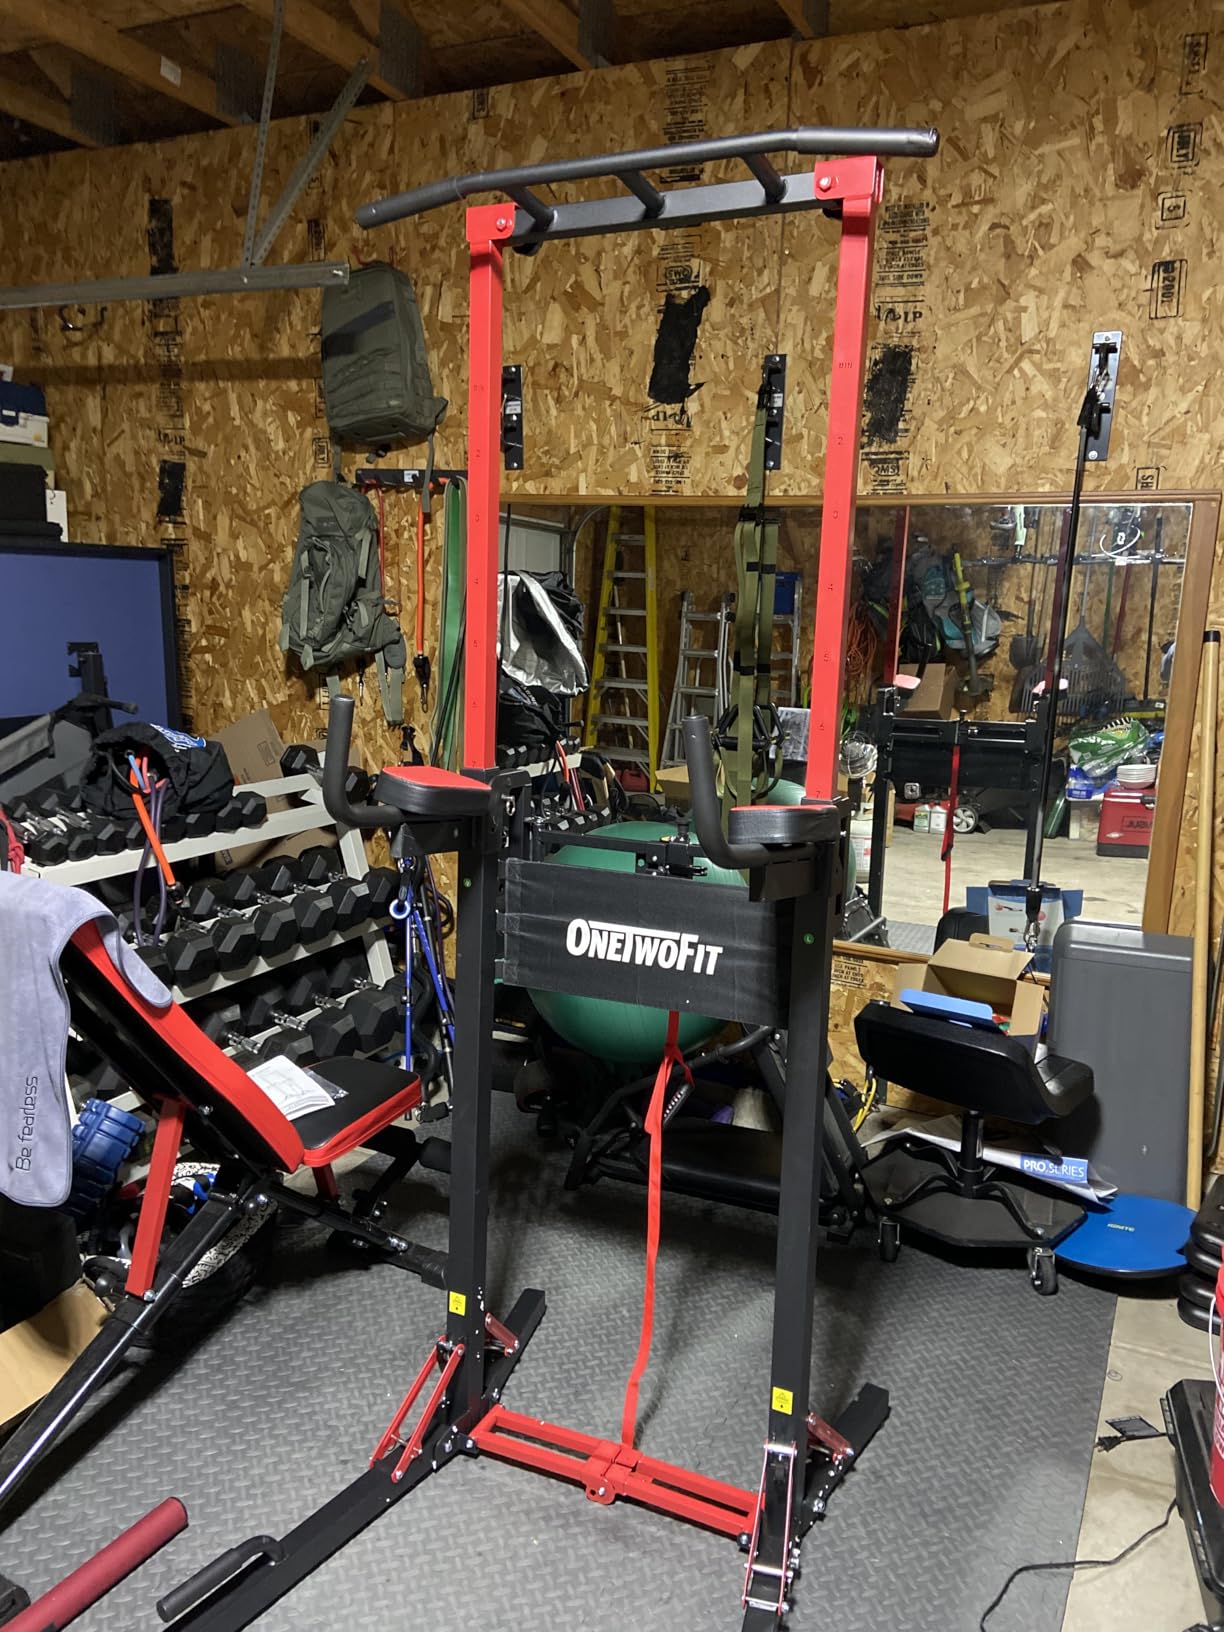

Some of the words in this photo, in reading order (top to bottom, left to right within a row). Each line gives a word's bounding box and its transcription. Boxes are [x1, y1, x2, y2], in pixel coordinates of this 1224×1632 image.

[18, 1076, 38, 1142] fearless
[15, 1147, 32, 1171] Be
[1023, 1159, 1046, 1172] PRO
[1048, 1163, 1085, 1178] SERIES
